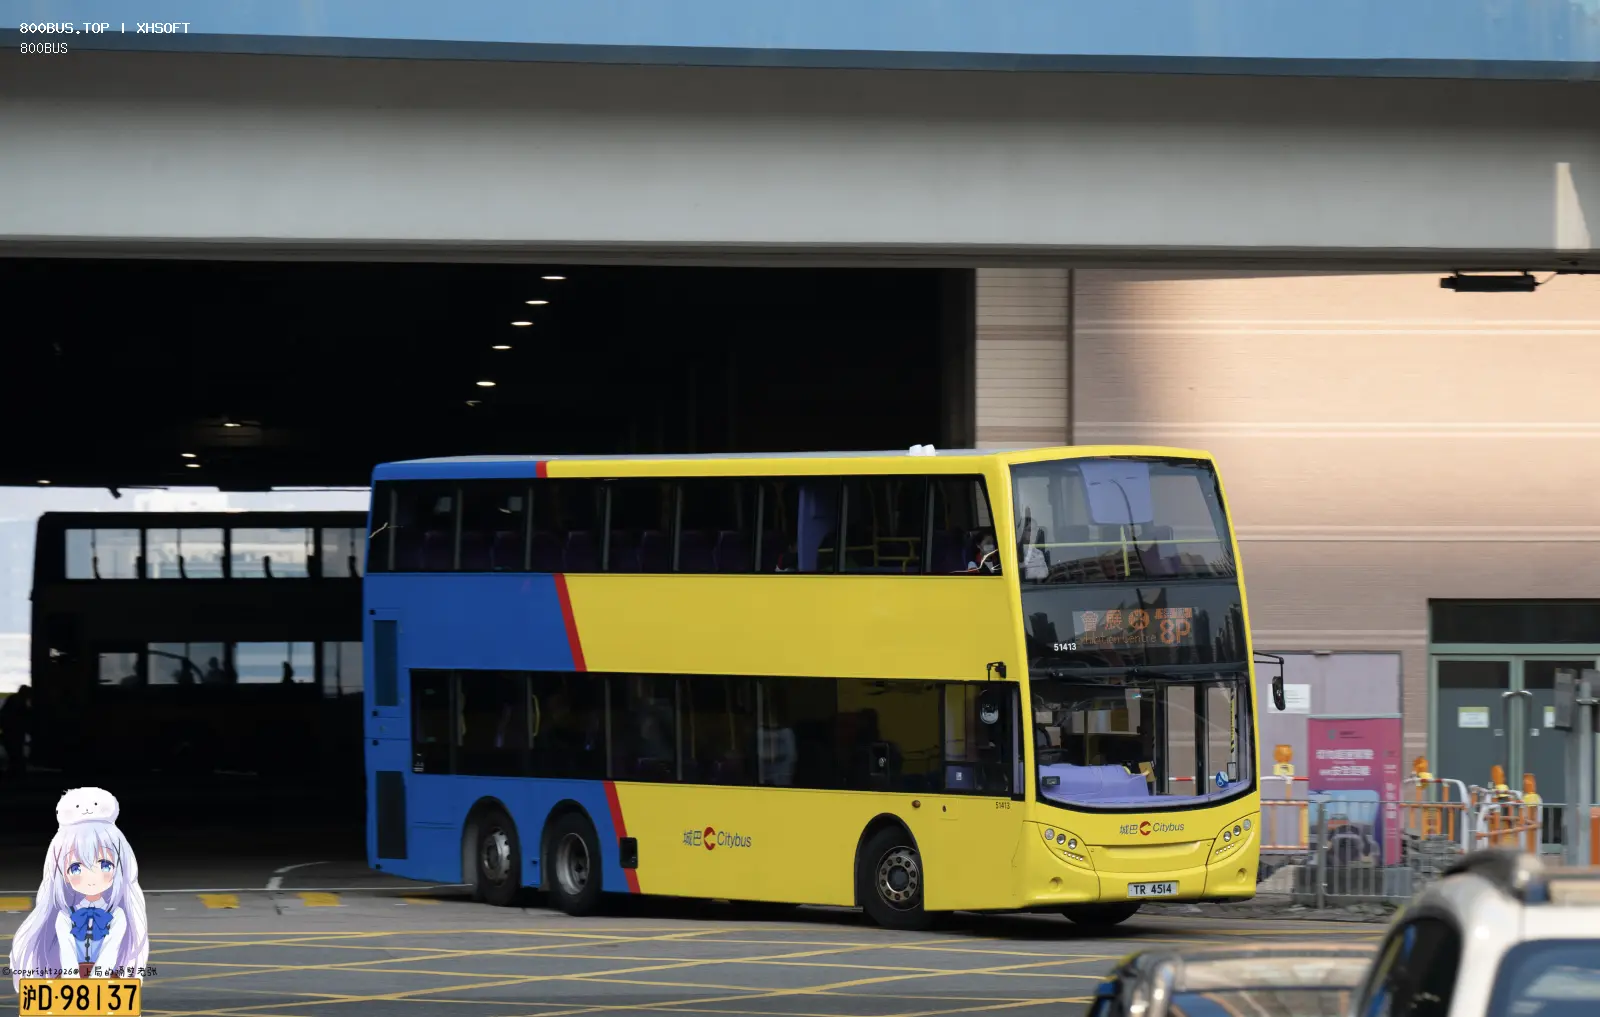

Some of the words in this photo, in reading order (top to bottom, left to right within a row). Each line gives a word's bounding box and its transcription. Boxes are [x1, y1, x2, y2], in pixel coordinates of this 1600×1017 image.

[1080, 610, 1123, 632] 會展
[1159, 619, 1191, 645] 8P
[1053, 642, 1077, 652] 51413
[1119, 824, 1138, 835] 城巴
[1152, 822, 1185, 834] Citybus
[683, 829, 702, 847] 城巴
[717, 830, 752, 848] Citybus
[1133, 884, 1146, 895] TR
[1151, 883, 1172, 894] 4514
